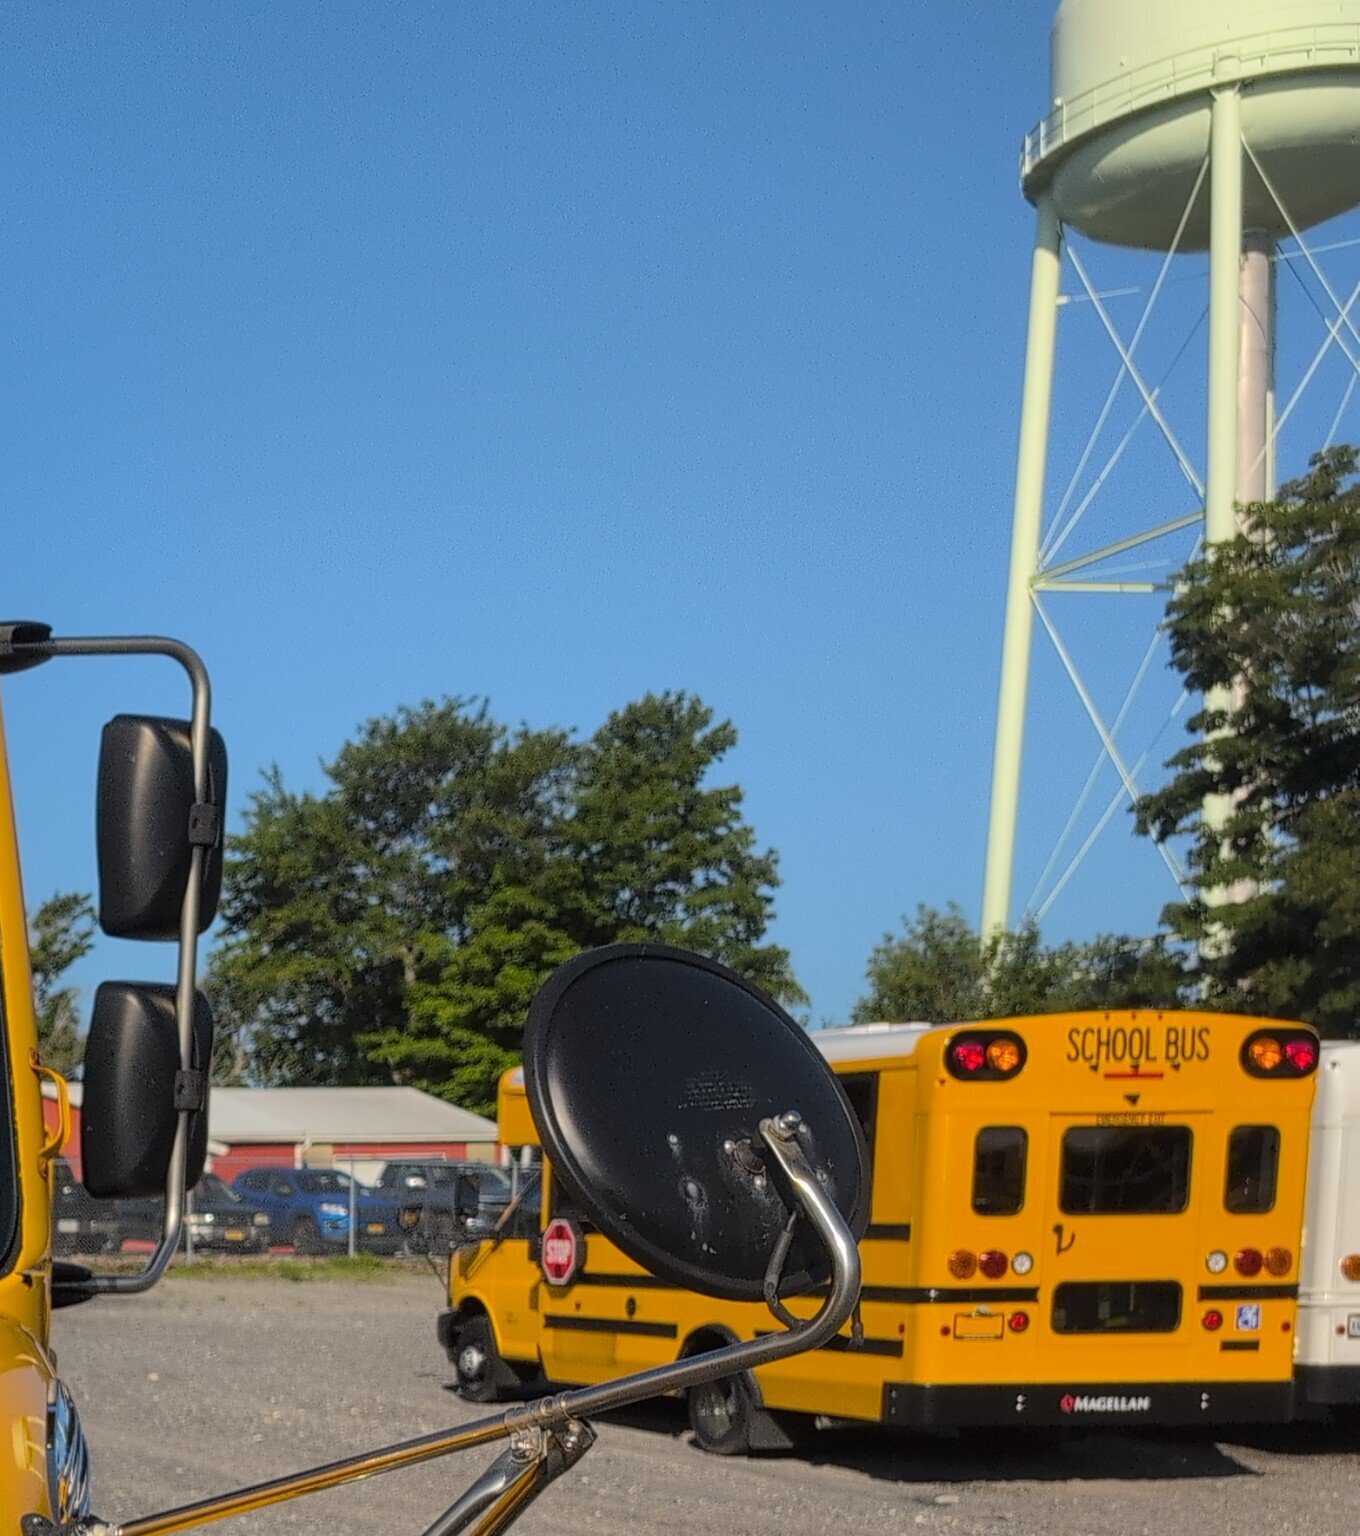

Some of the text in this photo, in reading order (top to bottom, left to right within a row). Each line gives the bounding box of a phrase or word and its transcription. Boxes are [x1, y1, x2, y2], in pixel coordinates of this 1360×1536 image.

[1066, 1026, 1211, 1063] SCHOOL BUS
[1074, 1396, 1151, 1412] MAGELLAN
